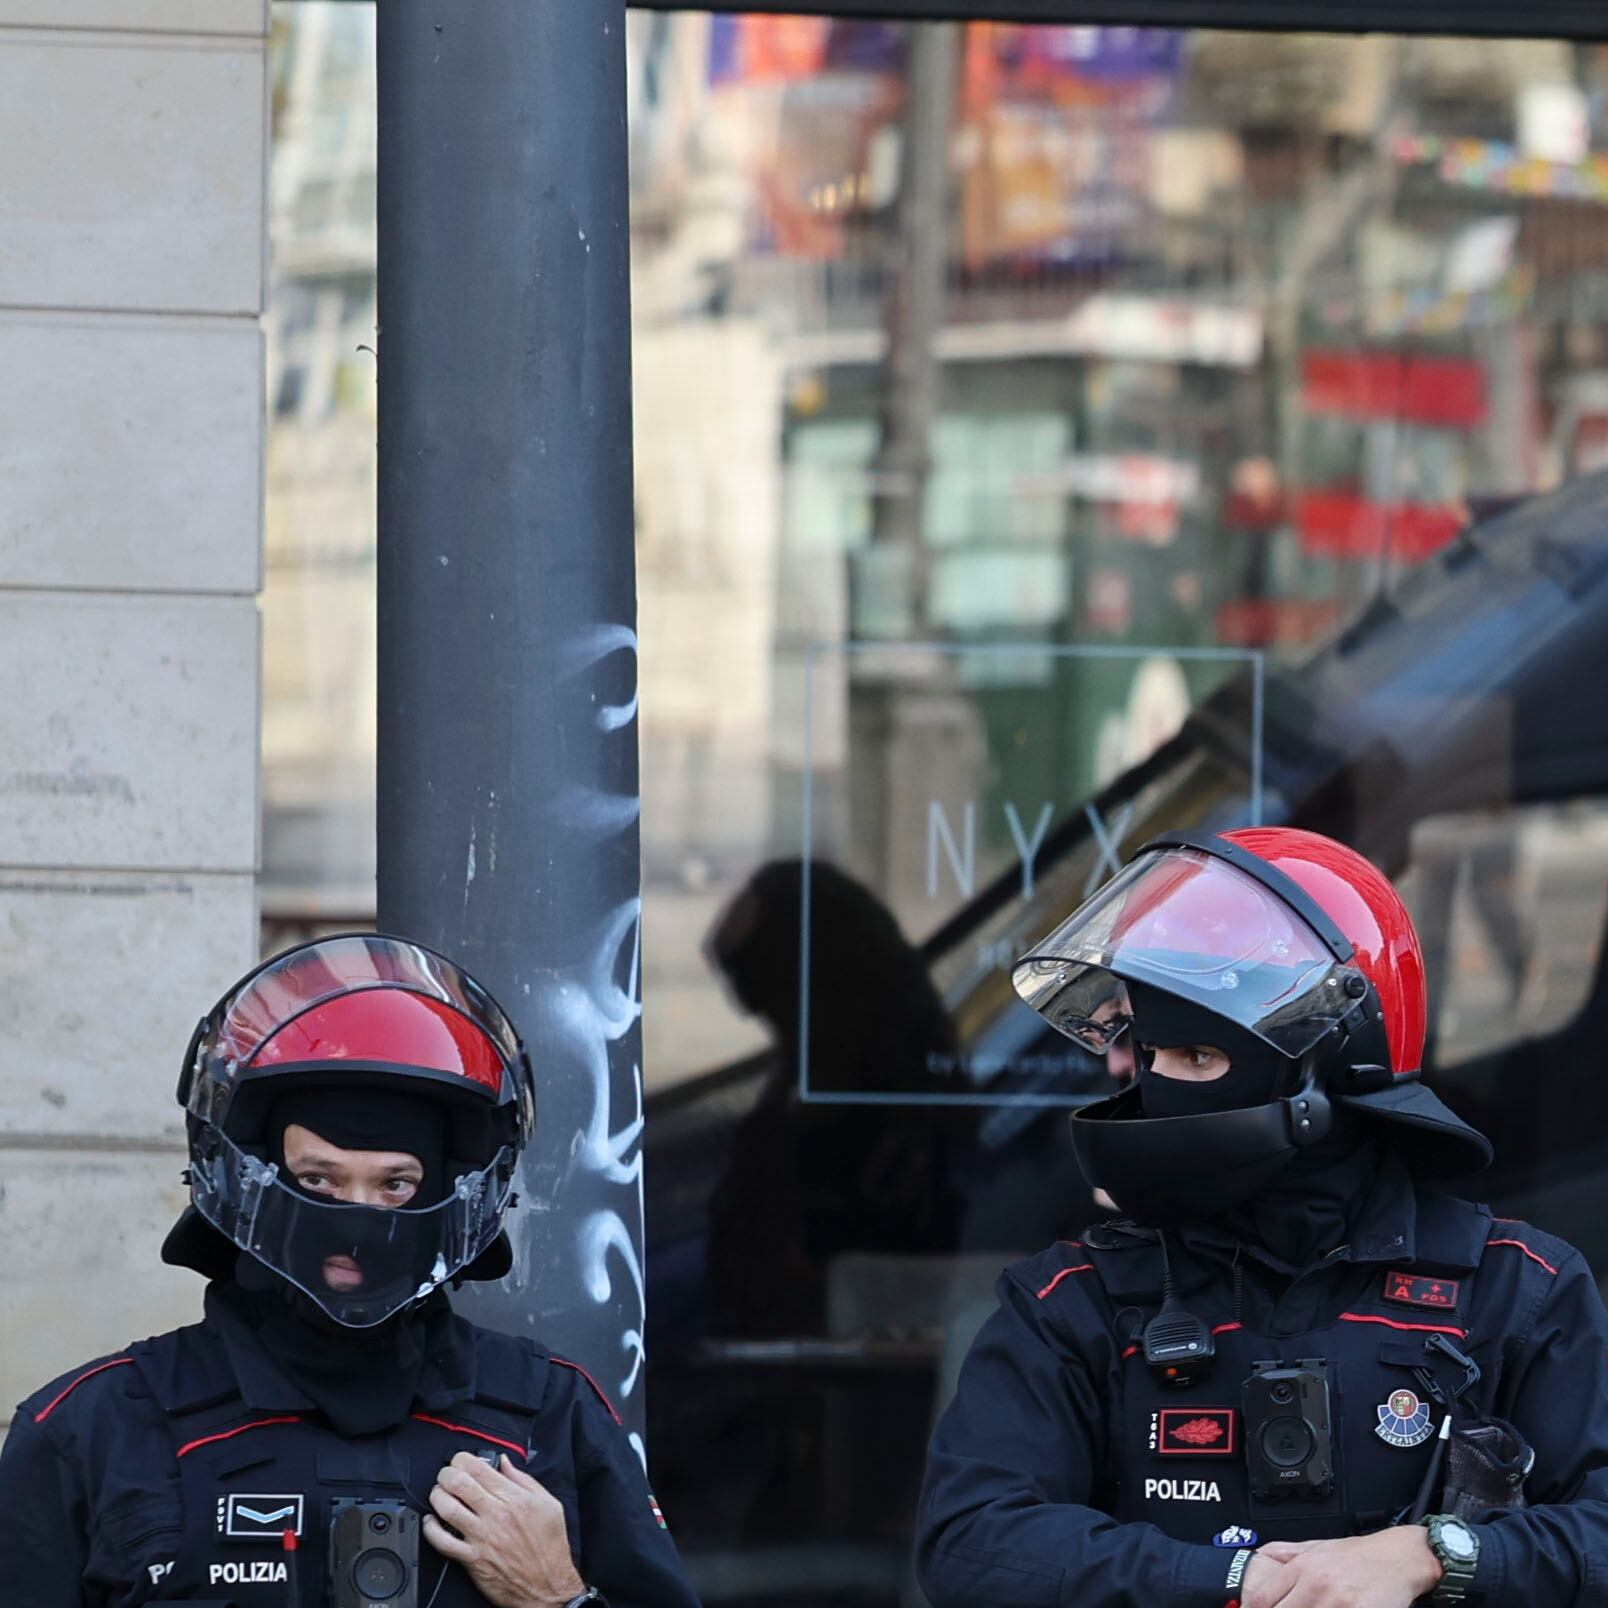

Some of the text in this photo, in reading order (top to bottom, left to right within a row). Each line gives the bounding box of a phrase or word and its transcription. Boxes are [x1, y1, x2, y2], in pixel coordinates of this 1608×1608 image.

[926, 801, 1136, 898] NYX
[1144, 1479, 1222, 1502] POLIZIA
[209, 1561, 288, 1585] POLIZIA
